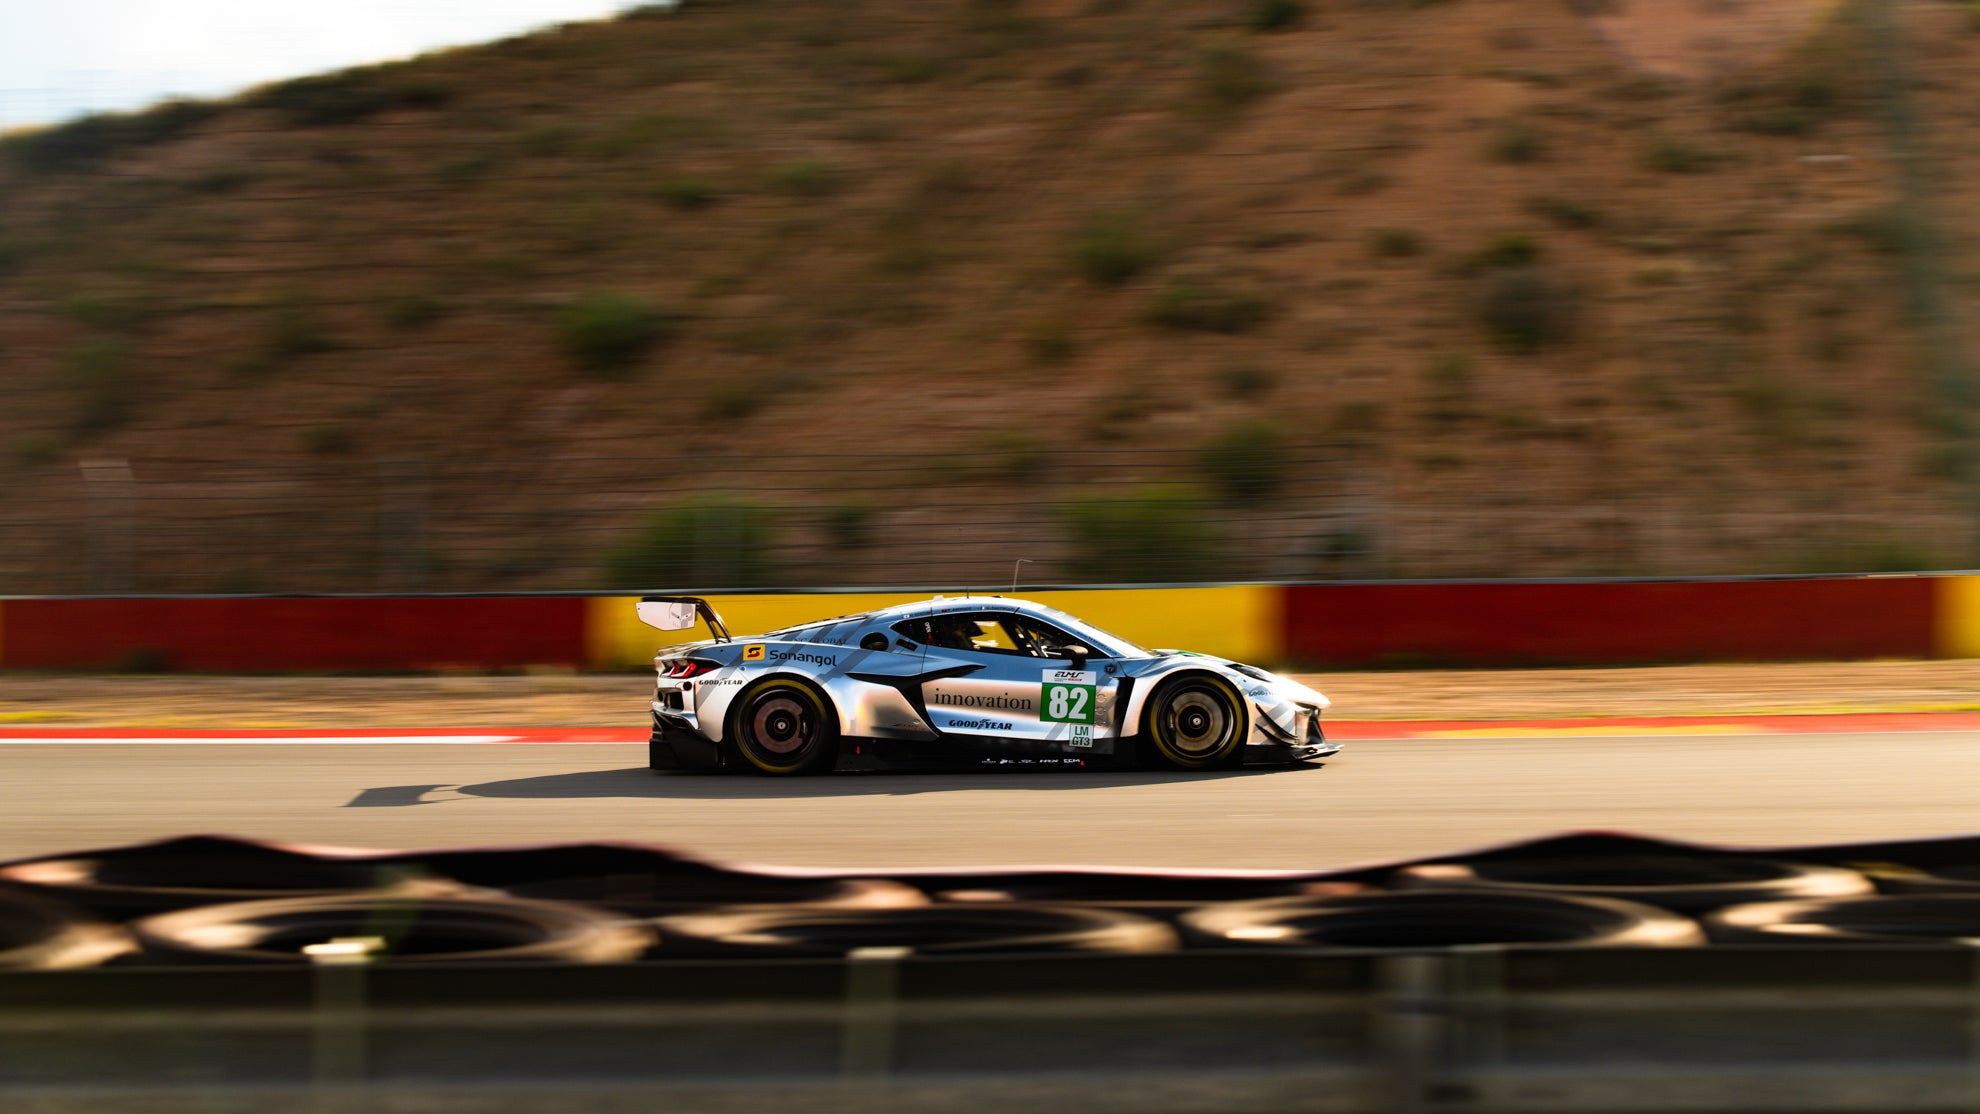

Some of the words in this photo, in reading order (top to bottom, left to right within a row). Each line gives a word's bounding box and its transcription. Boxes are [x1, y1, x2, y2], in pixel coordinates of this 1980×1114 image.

[769, 650, 837, 667] Sonangol
[698, 678, 743, 686] GOODYEAR
[935, 688, 1032, 710] innovation
[1048, 686, 1089, 719] 82
[948, 719, 1013, 730] GOODYEAR
[1075, 726, 1089, 736] LM
[1072, 736, 1090, 746] GT3
